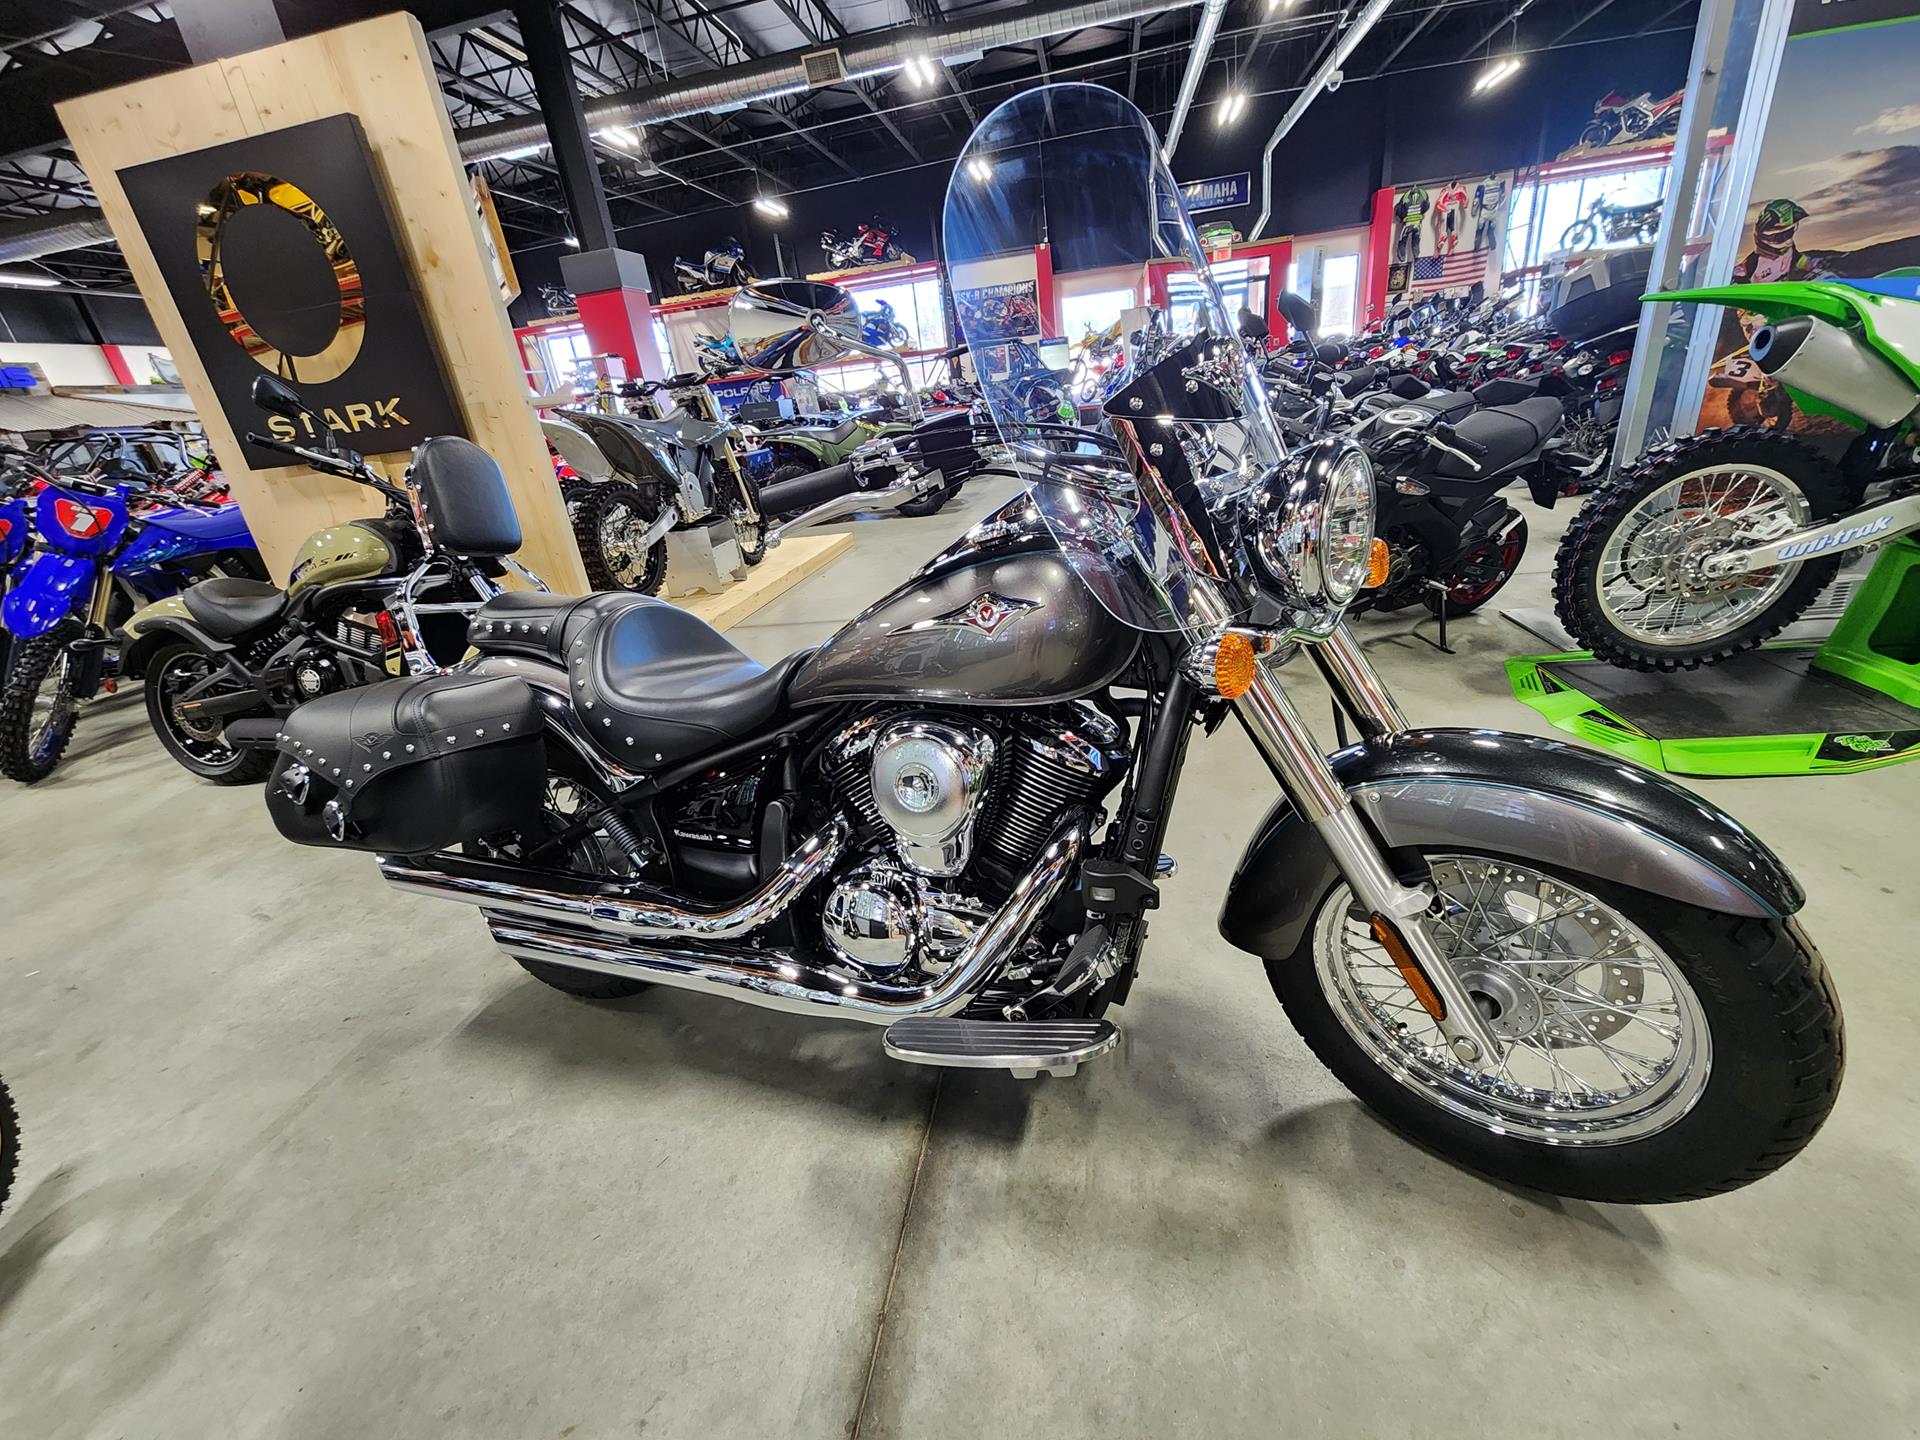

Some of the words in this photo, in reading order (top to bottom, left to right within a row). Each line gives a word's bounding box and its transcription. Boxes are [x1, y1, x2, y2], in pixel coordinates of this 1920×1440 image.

[1187, 181, 1238, 201] YAMAHA
[982, 281, 1034, 298] CHAMPIONS
[714, 382, 772, 398] POLARIS
[267, 397, 411, 443] STARK
[1777, 515, 1894, 561] uni-trak
[673, 829, 713, 841] Kawasaki
